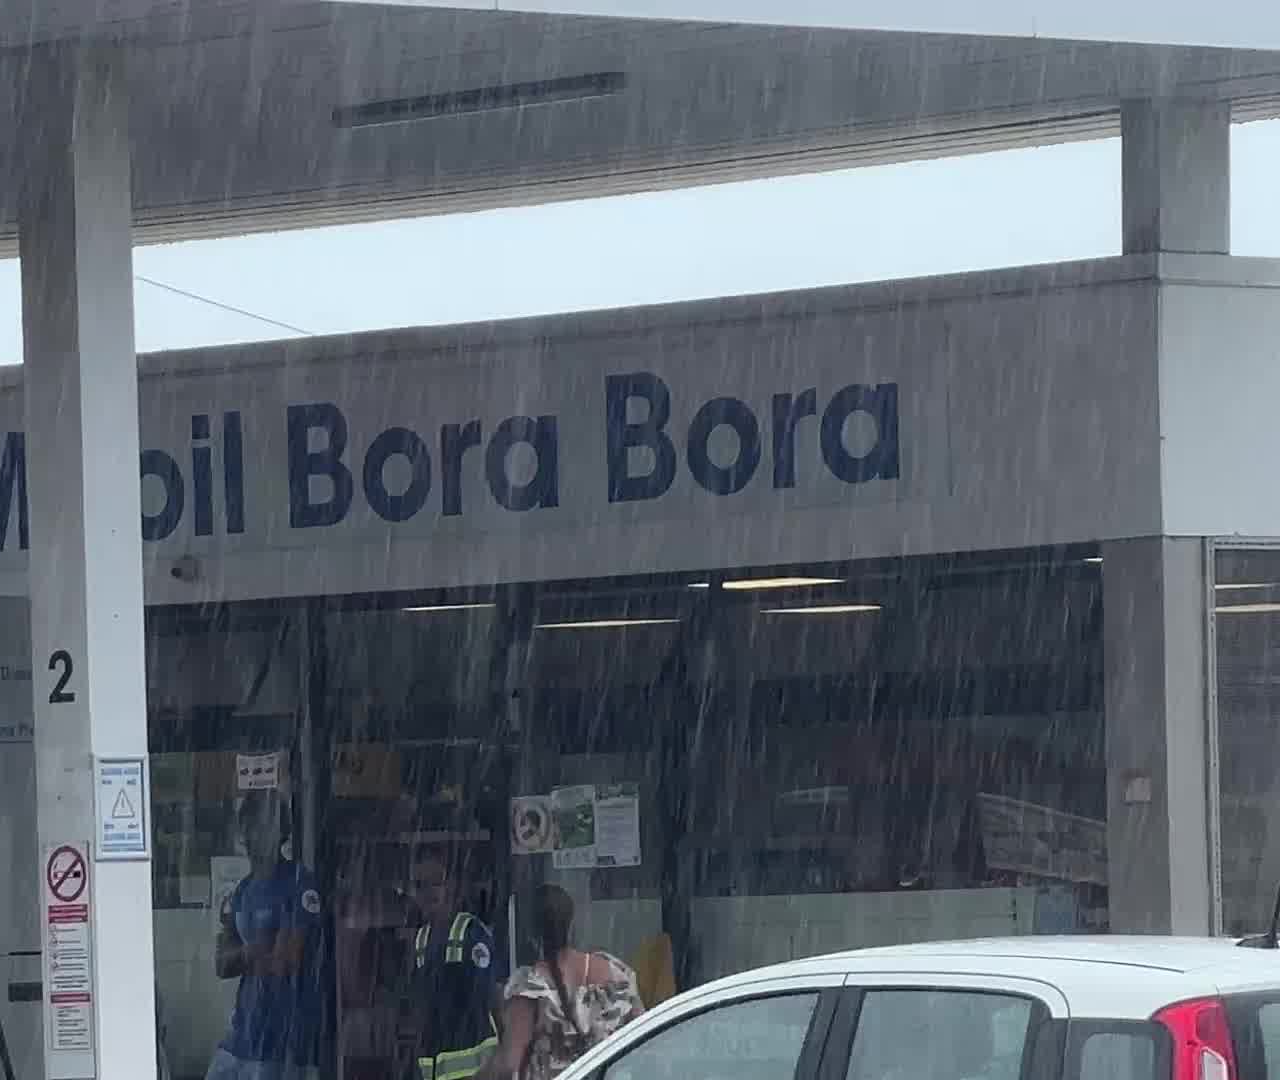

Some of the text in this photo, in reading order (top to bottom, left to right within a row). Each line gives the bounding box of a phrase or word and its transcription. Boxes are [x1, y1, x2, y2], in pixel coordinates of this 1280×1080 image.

[286, 401, 559, 530] Bora
[603, 371, 902, 504] Bora
[48, 649, 75, 704] 2
